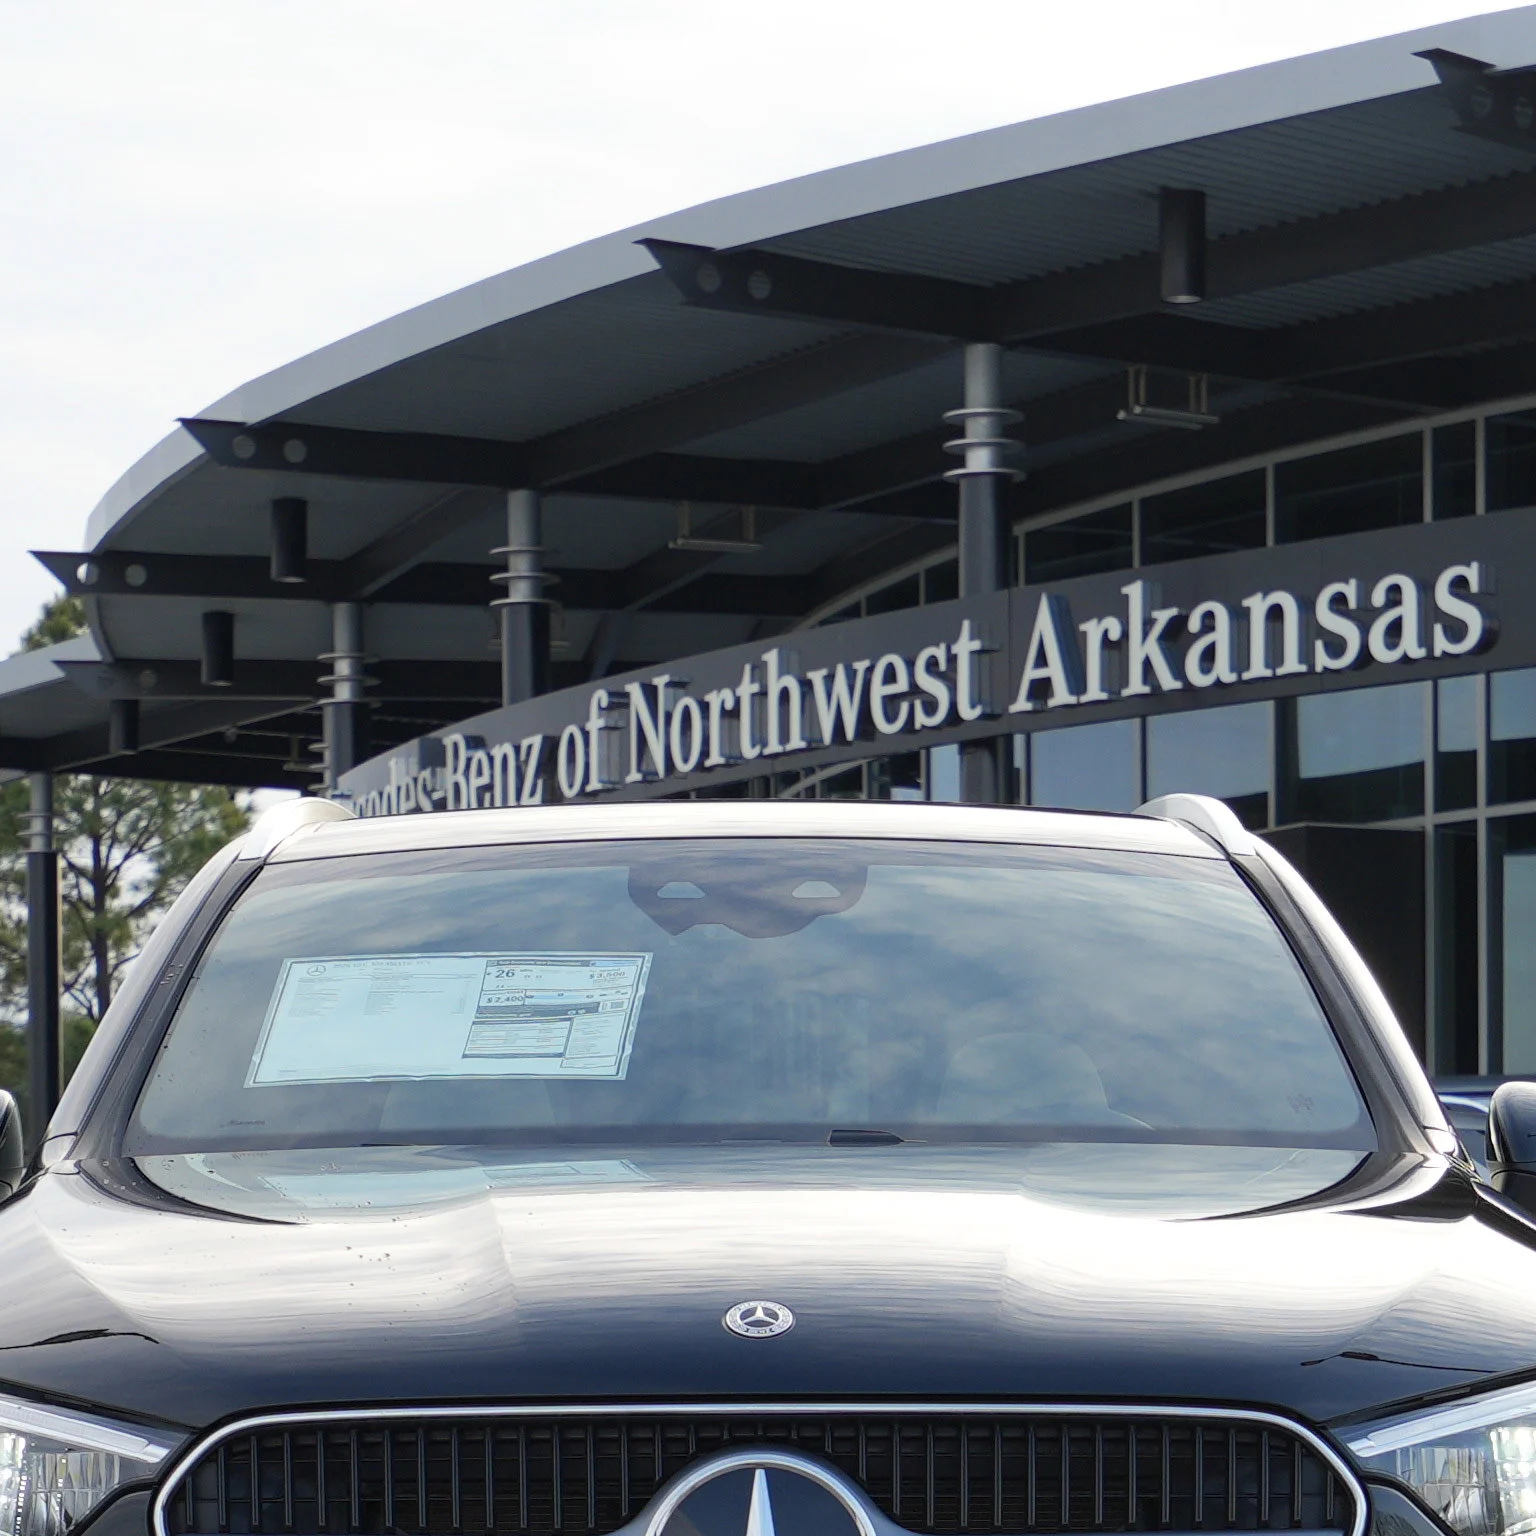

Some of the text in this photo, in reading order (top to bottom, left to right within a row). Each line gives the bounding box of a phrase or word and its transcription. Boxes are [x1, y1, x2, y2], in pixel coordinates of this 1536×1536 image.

[350, 561, 1485, 817] edes-Benz of Northwest Arkansas
[495, 969, 516, 979] 26
